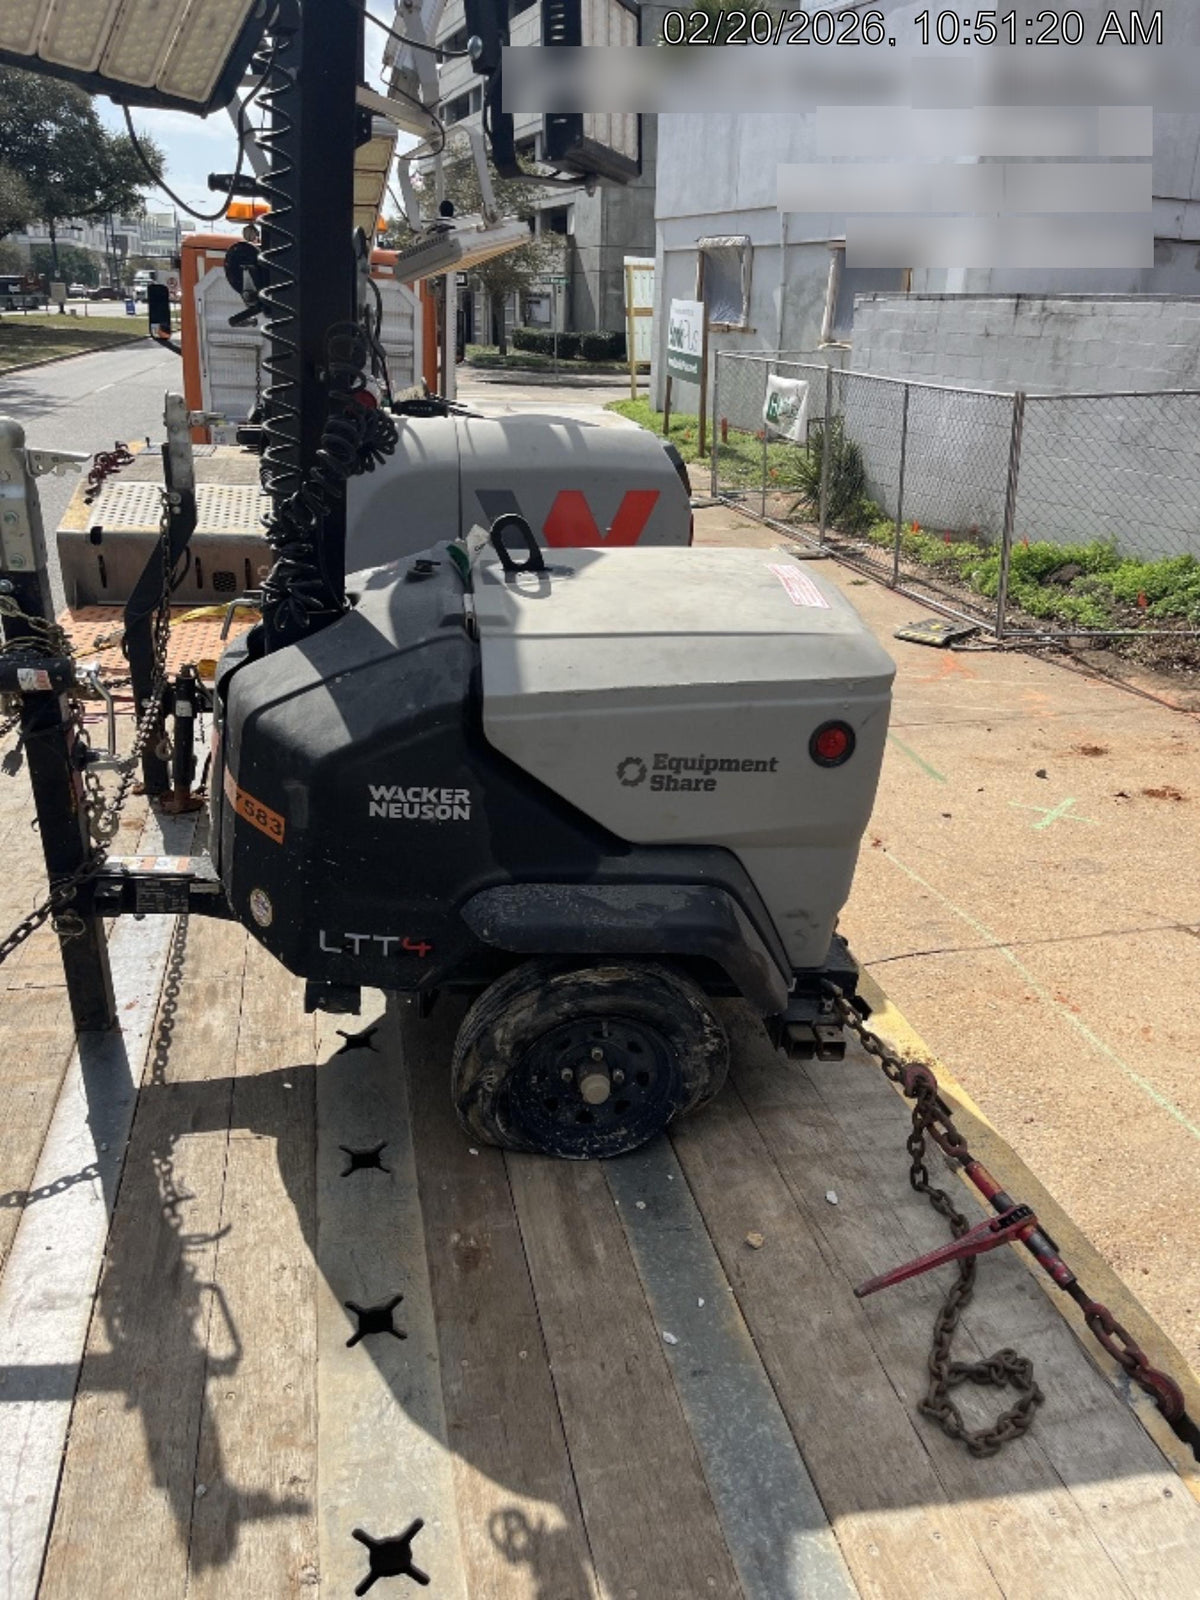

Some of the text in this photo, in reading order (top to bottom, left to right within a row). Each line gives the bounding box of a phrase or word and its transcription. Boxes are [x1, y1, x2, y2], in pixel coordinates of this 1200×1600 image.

[652, 753, 779, 775] Equipment
[650, 775, 717, 792] Share
[367, 784, 471, 804] WACKER
[368, 801, 471, 820] NEUSON
[319, 929, 432, 958] LTT4
